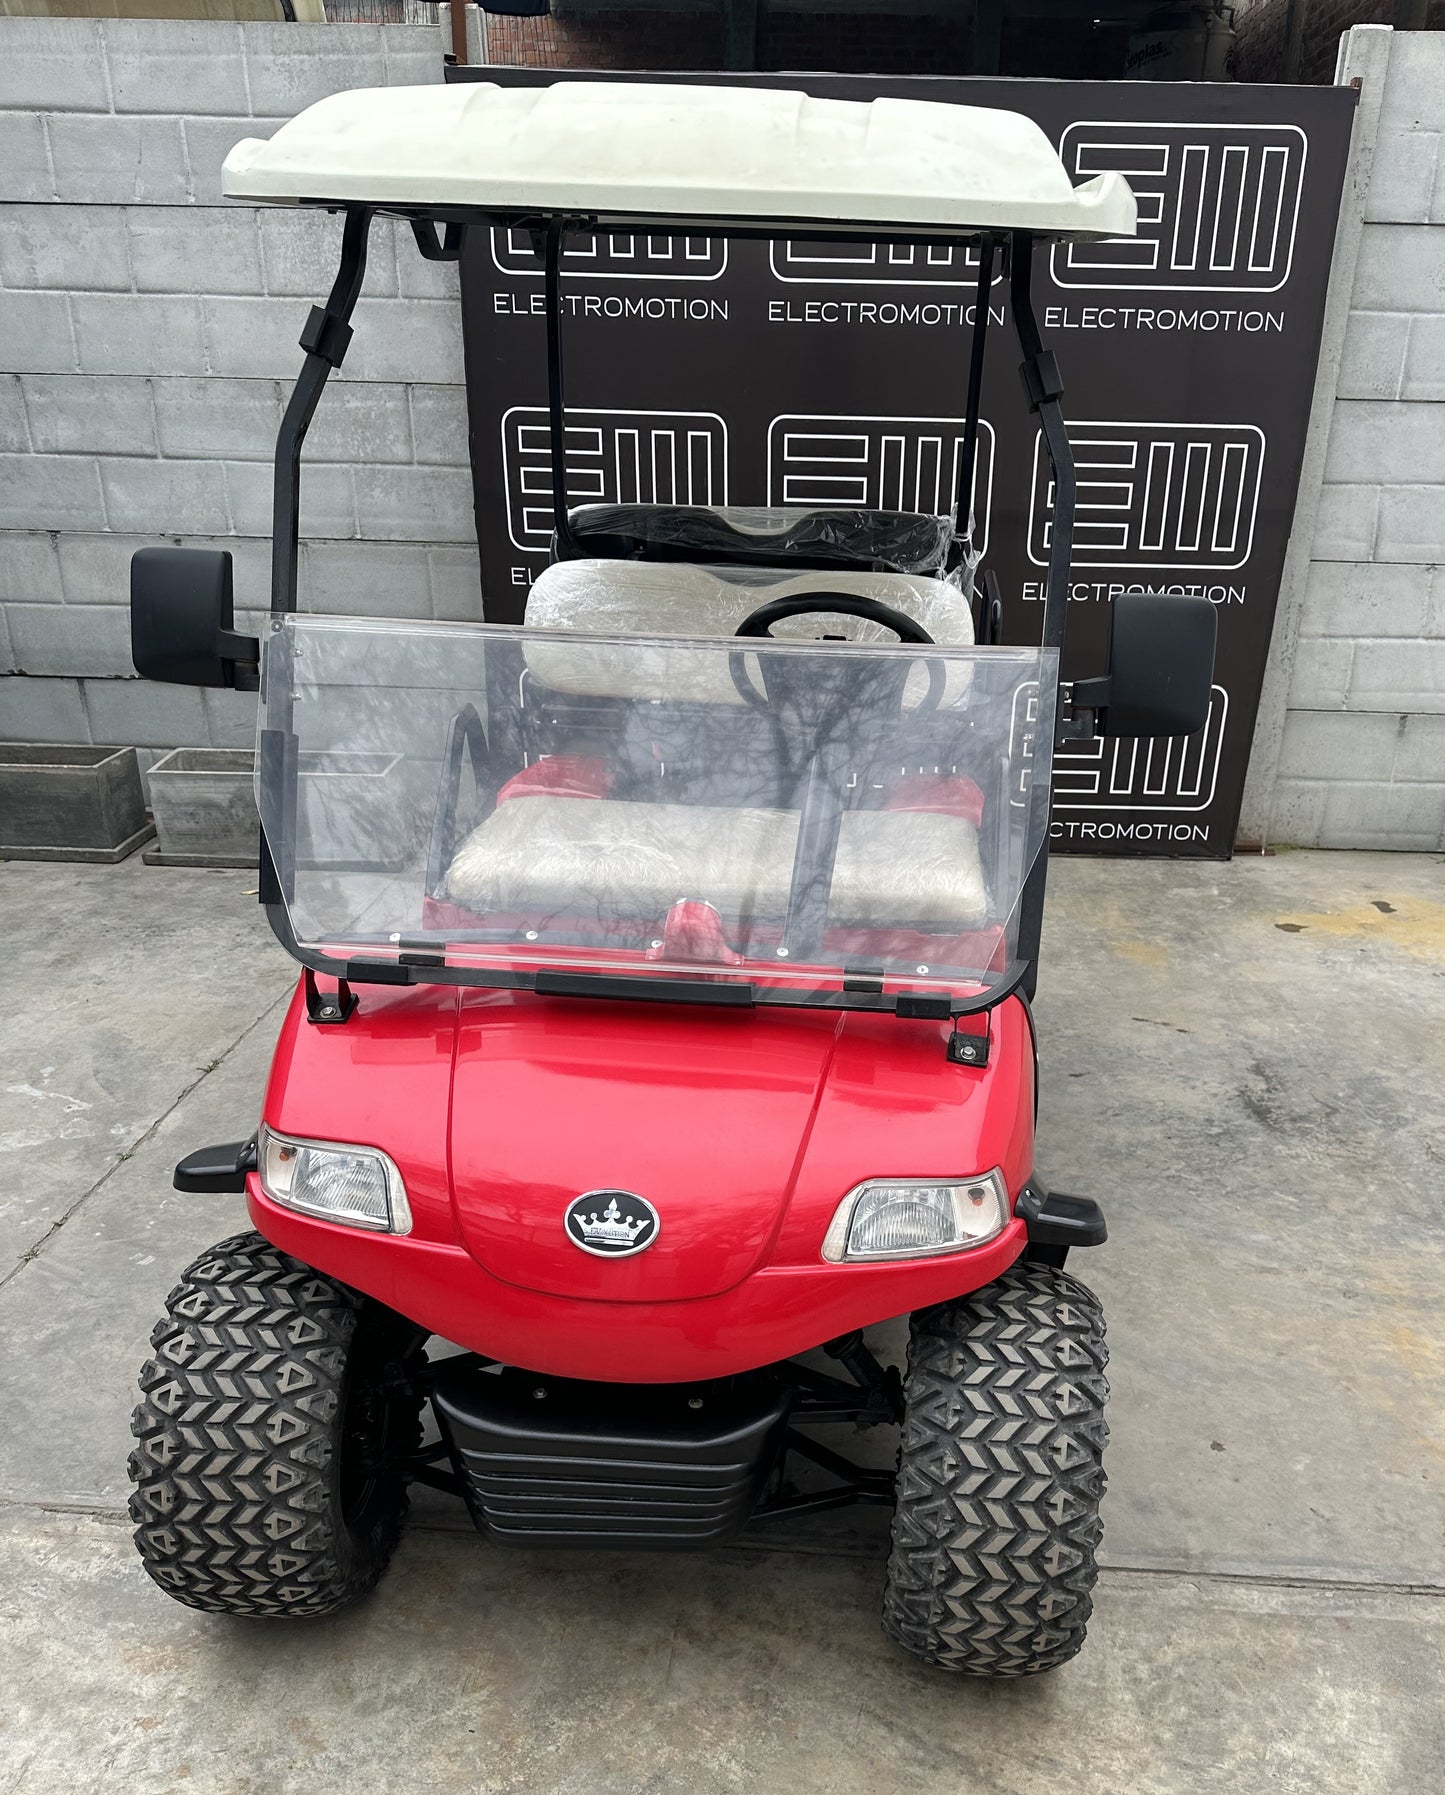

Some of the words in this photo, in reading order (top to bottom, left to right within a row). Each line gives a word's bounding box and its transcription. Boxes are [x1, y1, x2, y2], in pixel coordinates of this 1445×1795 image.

[493, 293, 729, 320] ELETROMOTION
[1044, 307, 1285, 332] ELECTROMOTION
[1022, 582, 1246, 604] ELCTROMOTION
[1049, 822, 1210, 841] CTROMOTION
